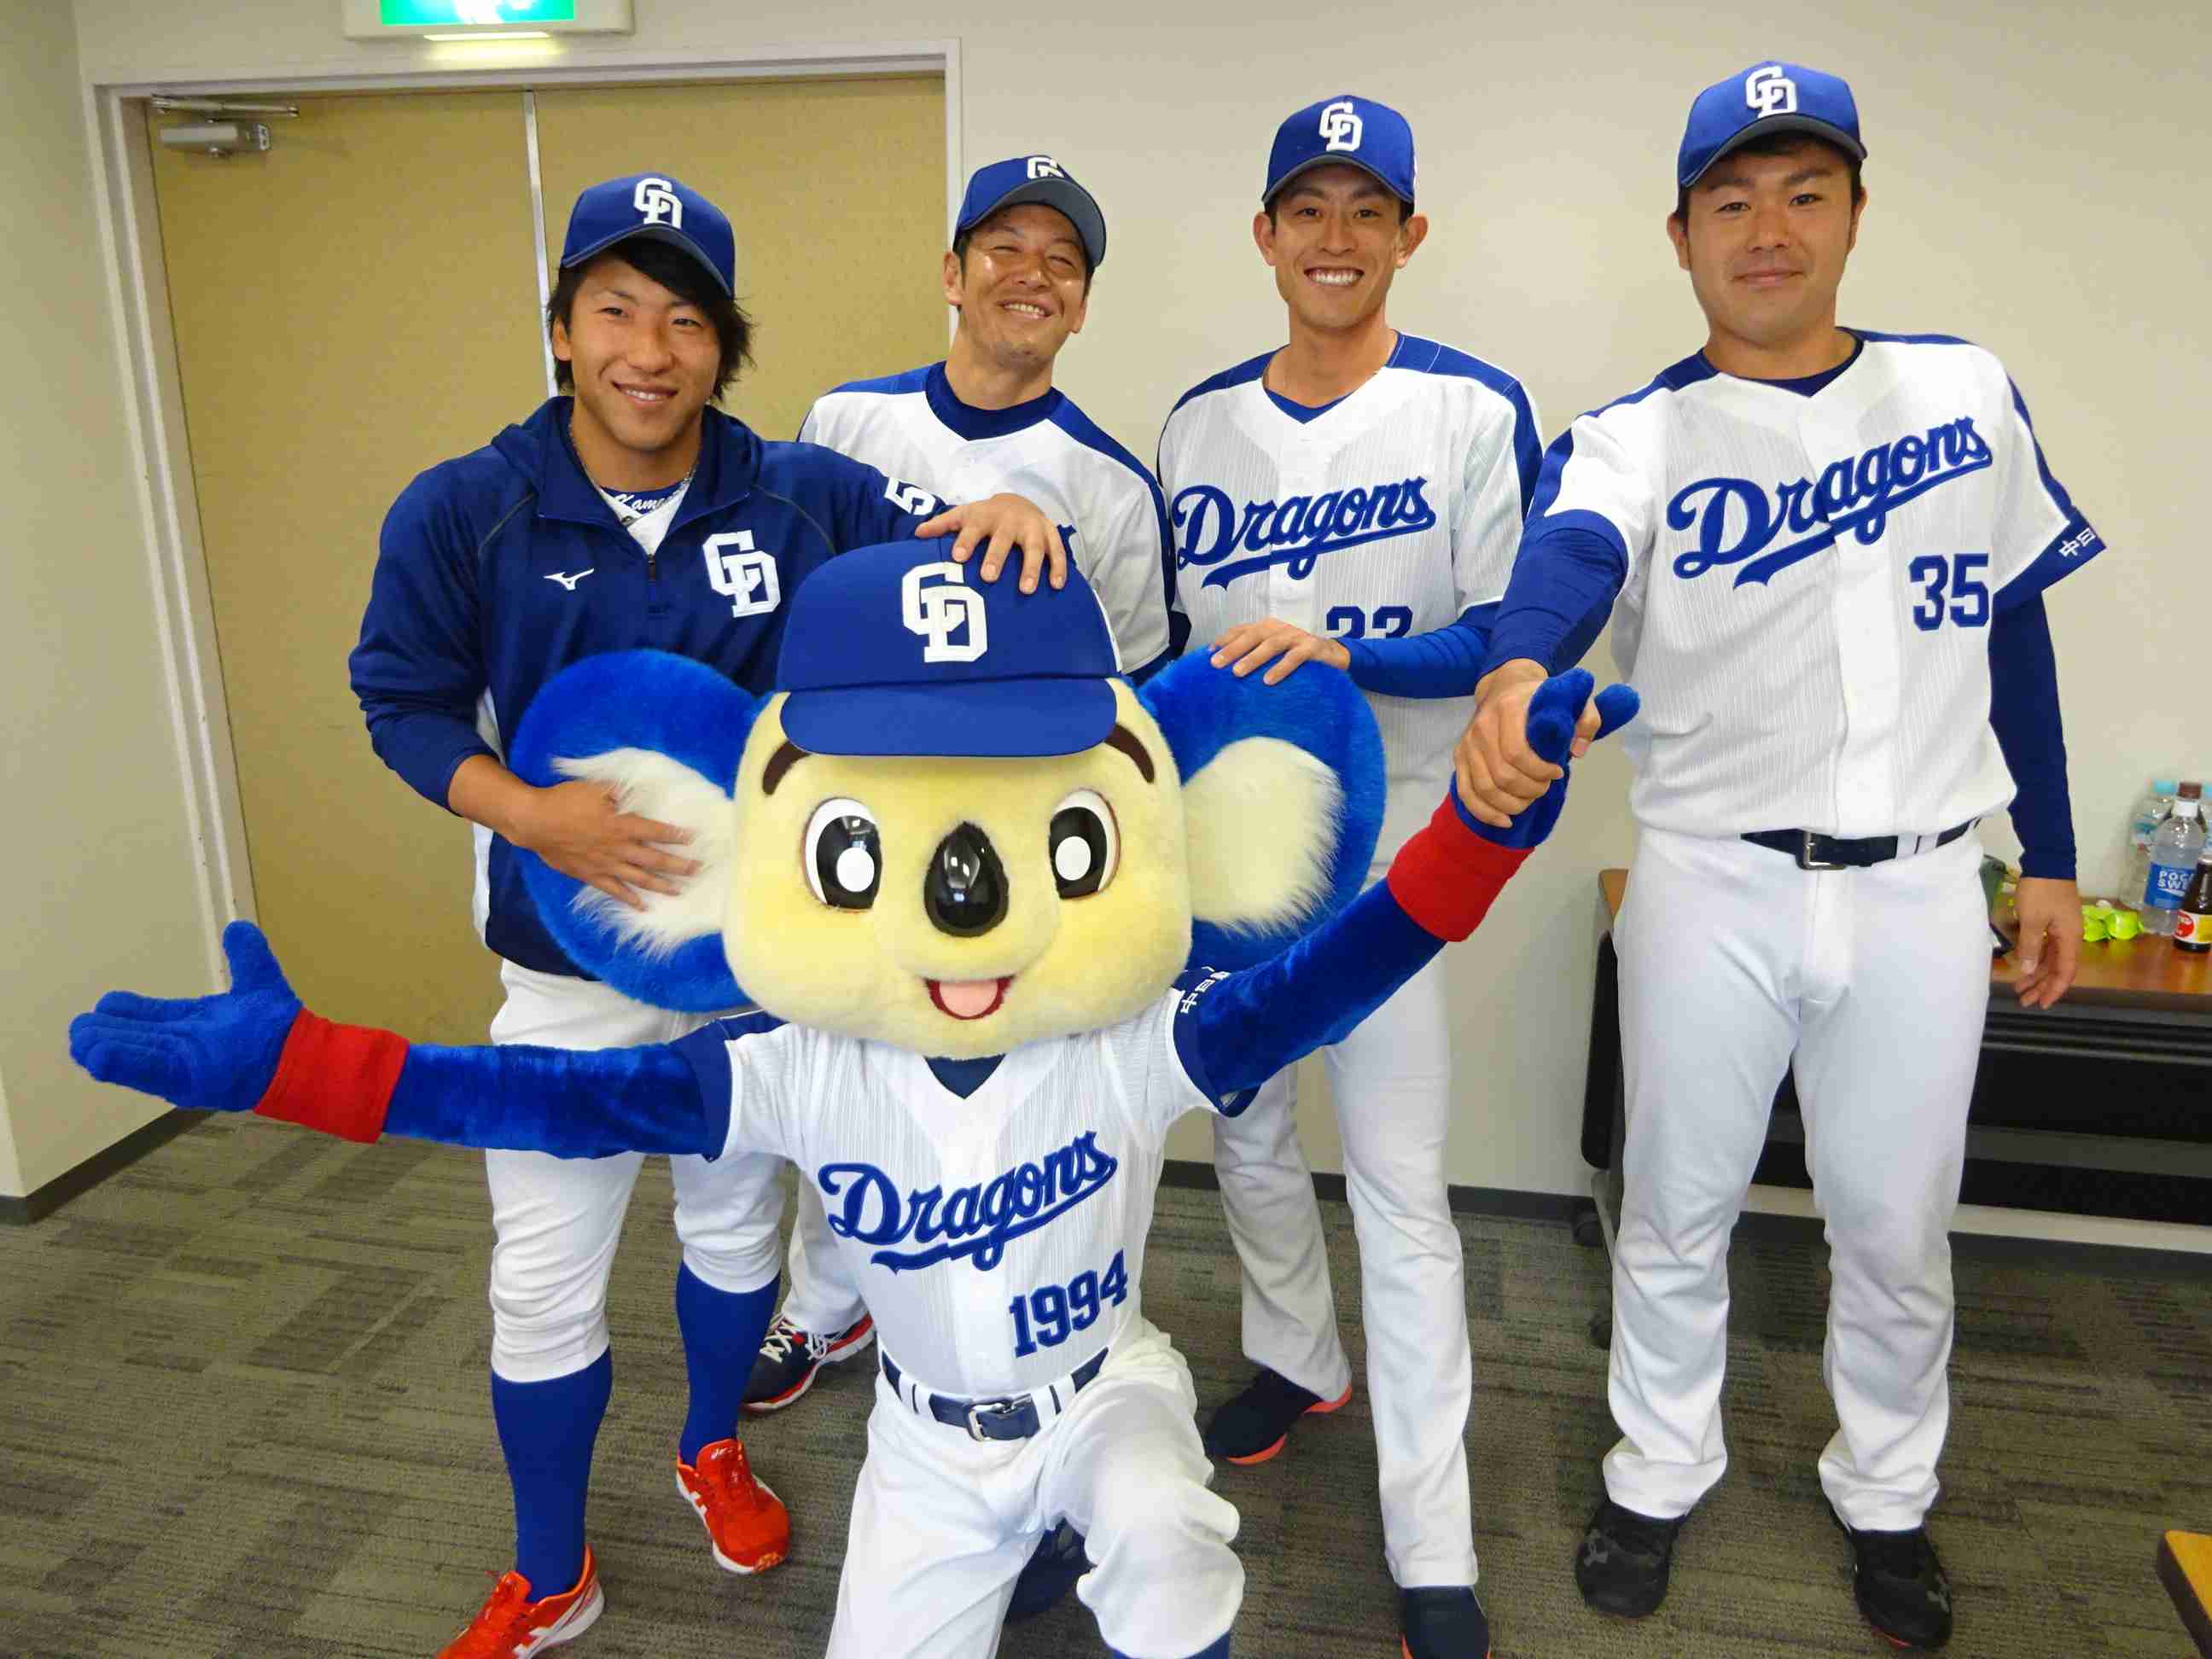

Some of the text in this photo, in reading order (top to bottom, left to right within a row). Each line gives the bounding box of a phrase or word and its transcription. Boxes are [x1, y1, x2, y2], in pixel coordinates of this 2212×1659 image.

[1172, 475, 1437, 591] Dragons
[1666, 415, 1994, 591] Dragons
[2058, 527, 2096, 556] 中日
[1908, 553, 1989, 631] 35
[817, 1130, 1119, 1275] Dragons
[1009, 1249, 1128, 1358] 1994
